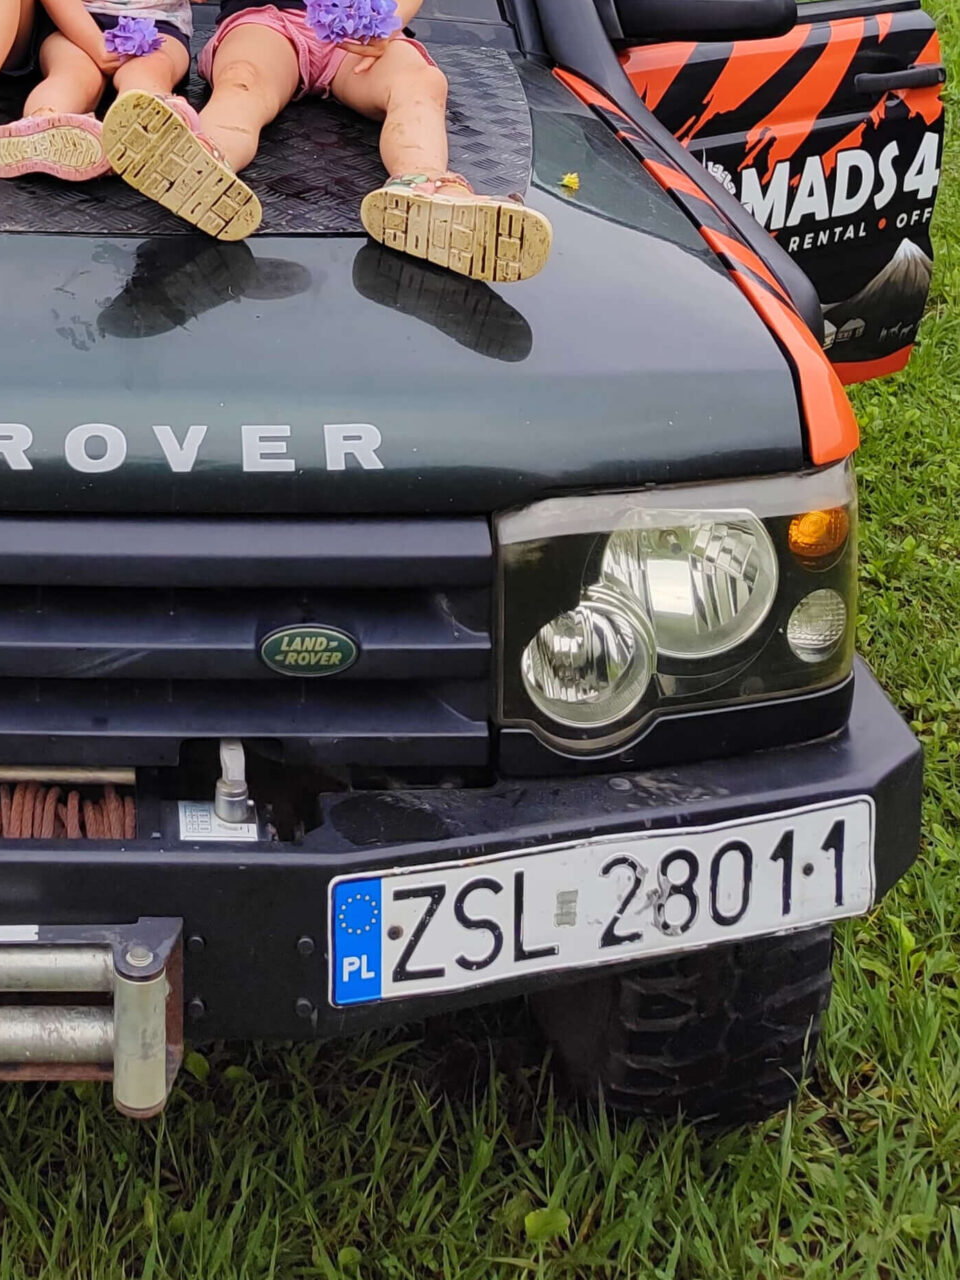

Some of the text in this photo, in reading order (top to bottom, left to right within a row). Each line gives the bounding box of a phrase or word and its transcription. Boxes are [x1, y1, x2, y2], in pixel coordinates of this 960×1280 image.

[789, 207, 933, 253] RENTAL OFF
[280, 636, 328, 651] LAND
[284, 652, 343, 665] ROVER
[391, 817, 846, 983] ZSL 28011
[342, 954, 376, 983] PL
